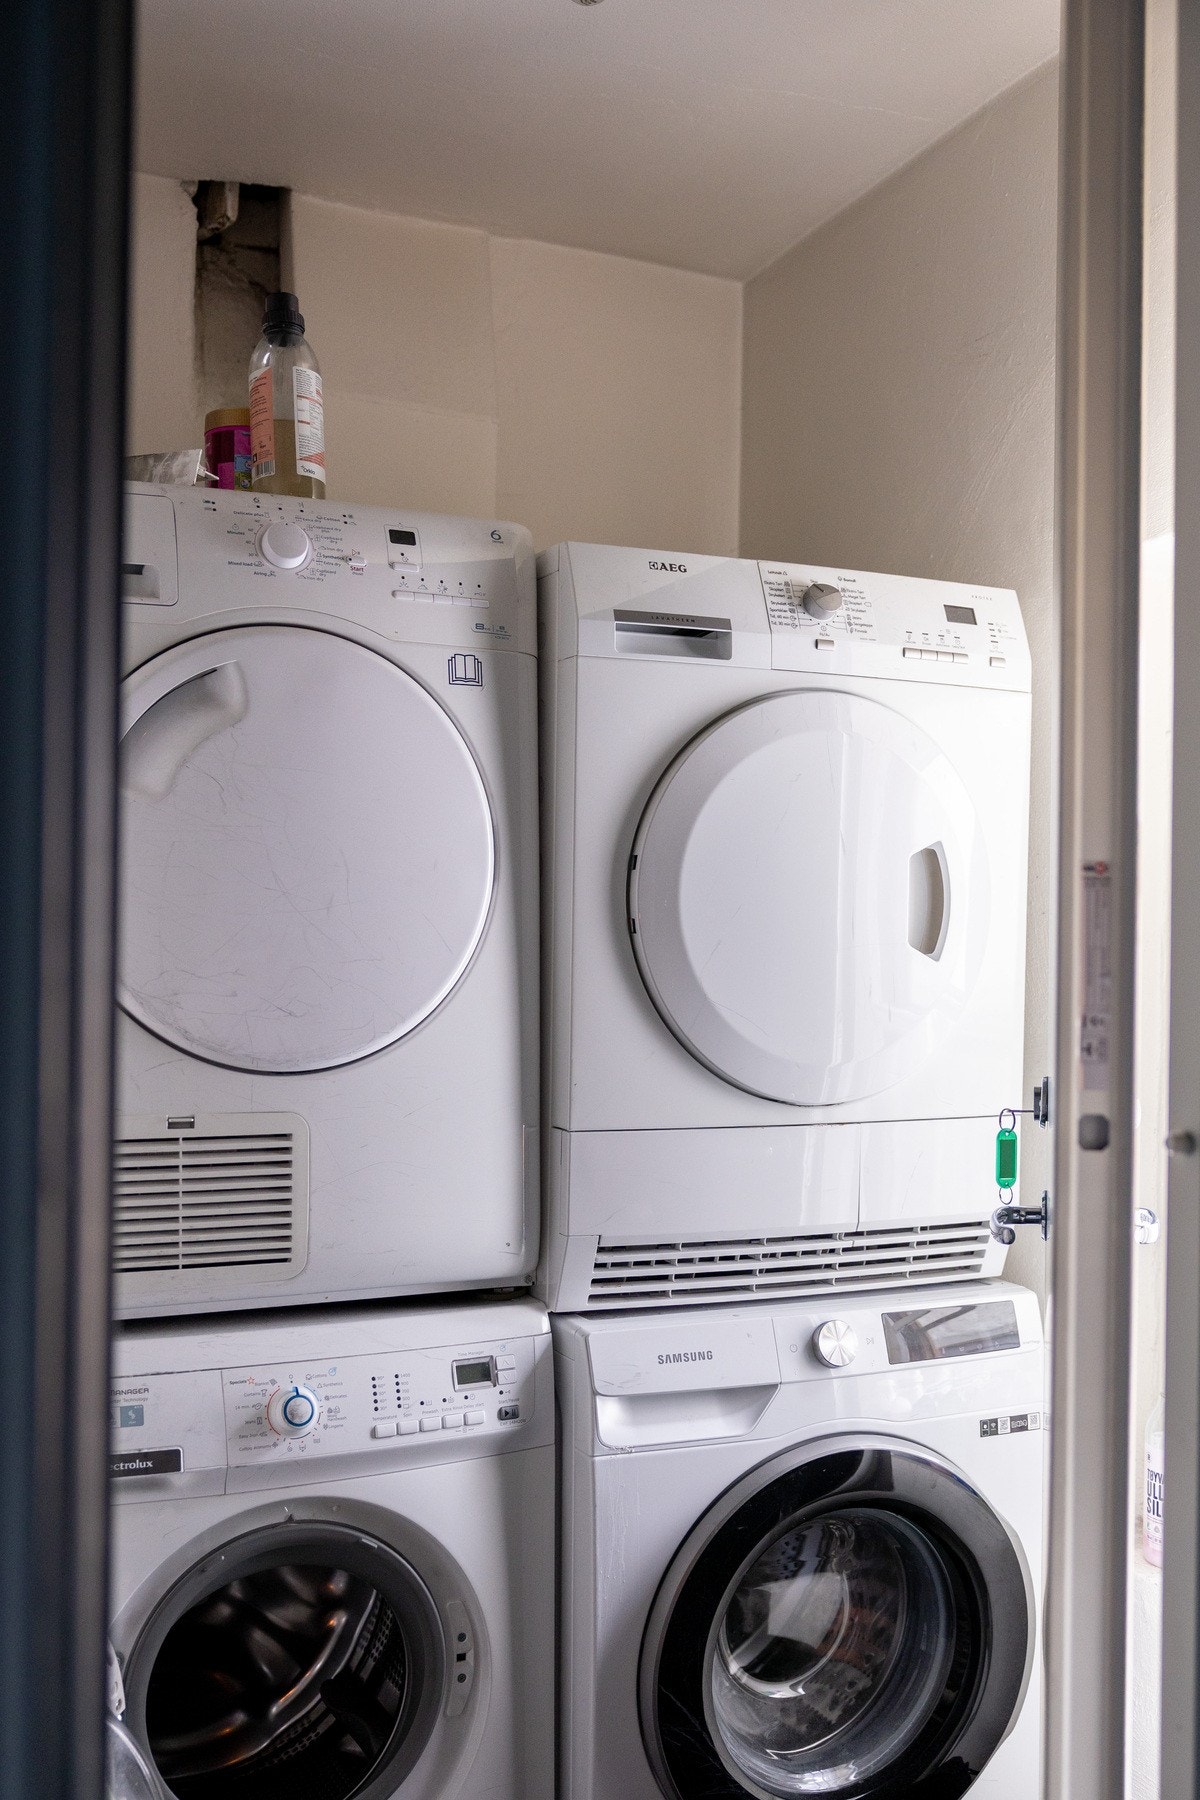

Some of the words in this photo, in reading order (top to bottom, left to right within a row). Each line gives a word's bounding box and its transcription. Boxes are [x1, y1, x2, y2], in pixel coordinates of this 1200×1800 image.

[491, 530, 502, 541] 6
[660, 562, 687, 573] AEG
[657, 1350, 714, 1365] SAMSUNG
[1147, 1468, 1165, 1485] TØYV
[1147, 1480, 1165, 1501] ULL
